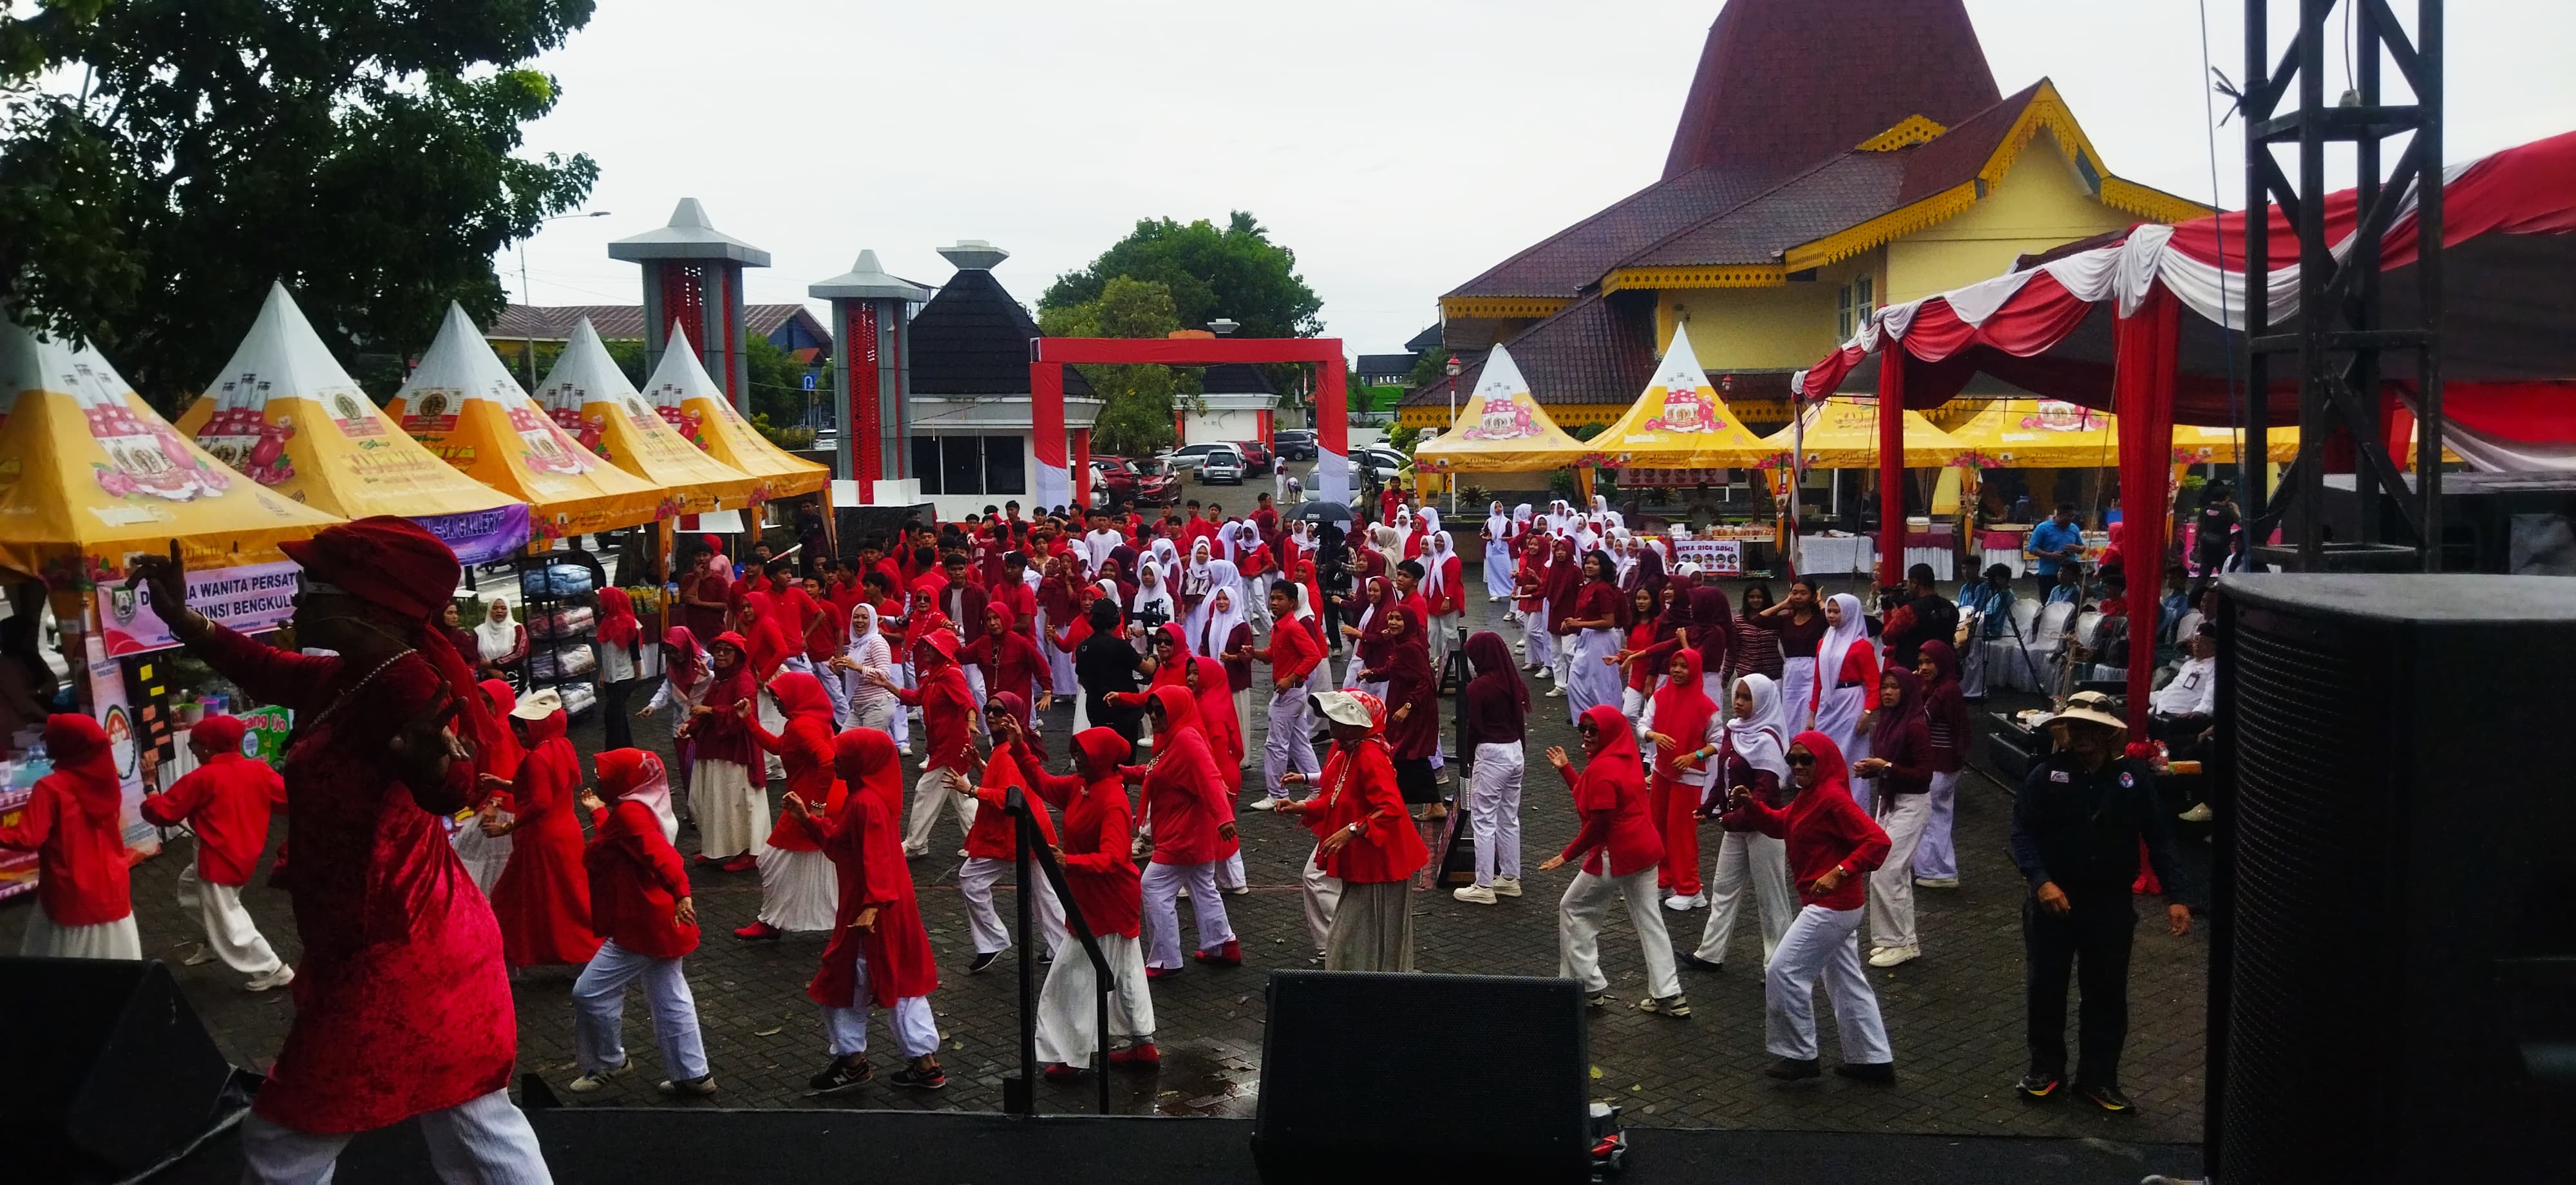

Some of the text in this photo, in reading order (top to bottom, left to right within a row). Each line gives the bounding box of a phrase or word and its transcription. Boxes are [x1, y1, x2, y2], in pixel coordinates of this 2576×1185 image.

[200, 579, 248, 597] WANITA
[252, 573, 298, 590] PERSAT
[193, 594, 293, 620] VINSI BENGKUL
